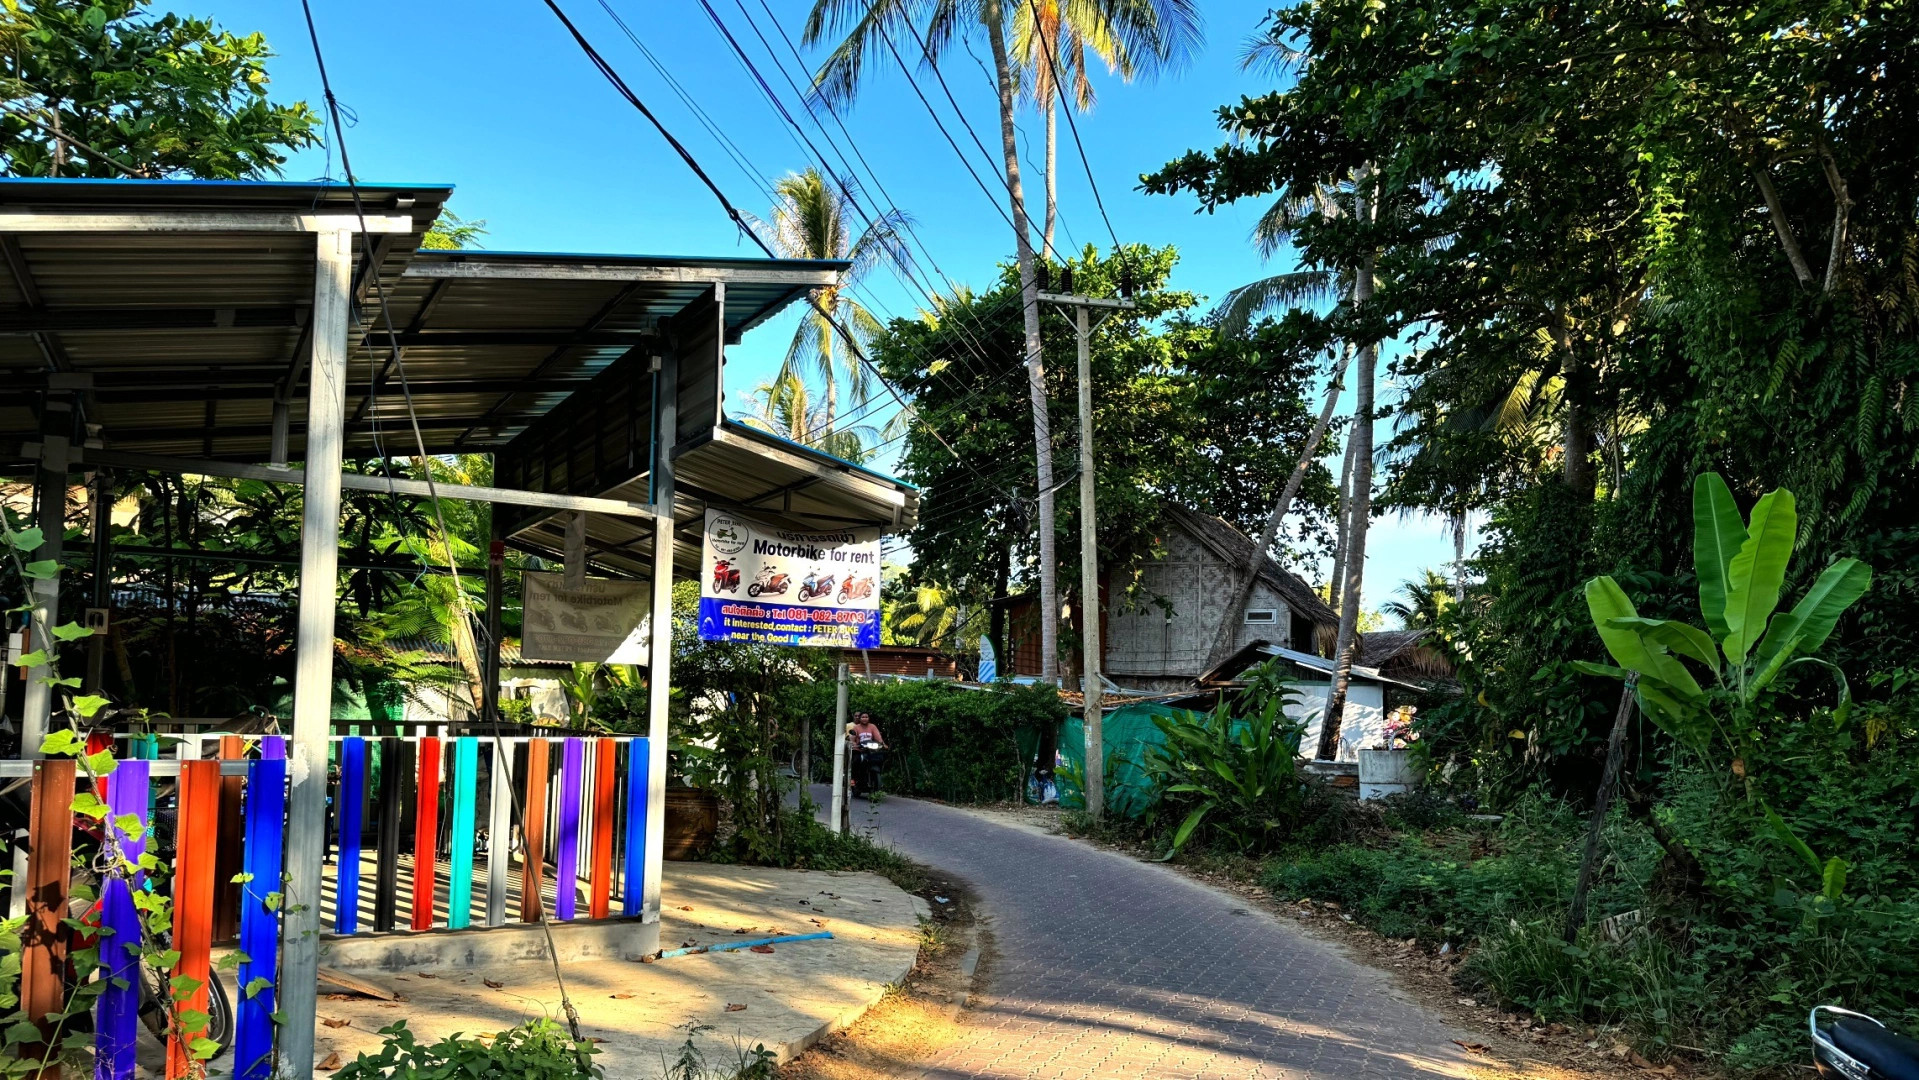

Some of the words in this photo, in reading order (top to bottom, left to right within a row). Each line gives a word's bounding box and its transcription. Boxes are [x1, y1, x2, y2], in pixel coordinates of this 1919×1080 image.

[753, 538, 826, 561] Motorbike
[830, 547, 847, 562] for
[850, 550, 874, 564] rent
[772, 608, 786, 620] Tel
[787, 608, 865, 623] 081-082-8703
[813, 624, 837, 633] PETER
[731, 632, 750, 640] near
[751, 632, 765, 641] the
[767, 633, 789, 643] Good
[790, 634, 808, 644] Lck
